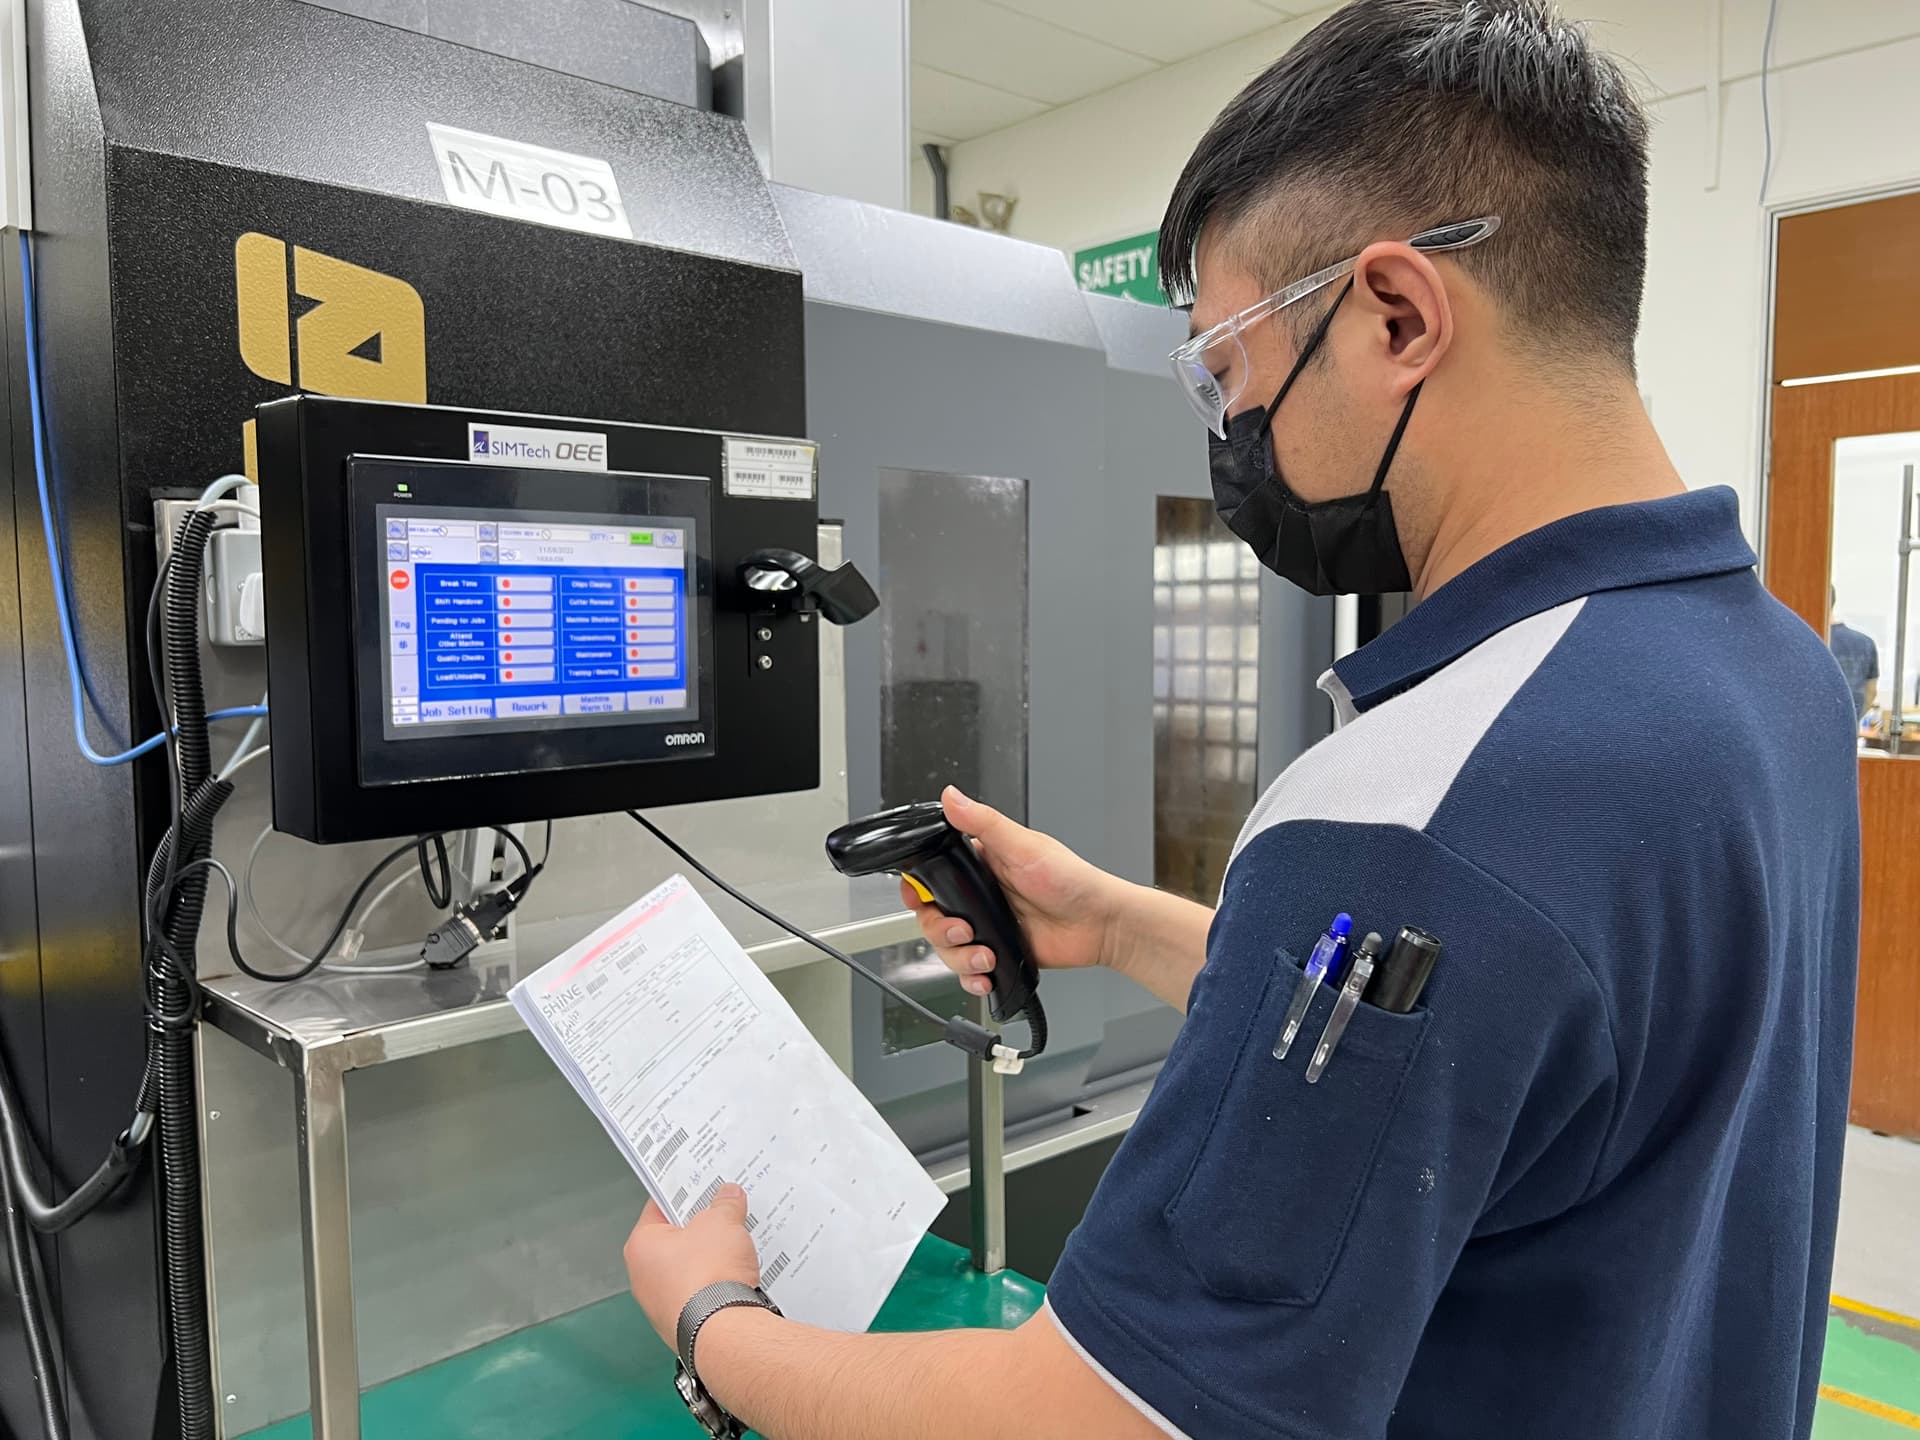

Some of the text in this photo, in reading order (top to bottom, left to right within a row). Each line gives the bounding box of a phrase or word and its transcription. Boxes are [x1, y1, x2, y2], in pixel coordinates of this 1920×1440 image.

[447, 150, 617, 223] M-03
[1079, 246, 1153, 291] SAFETY
[491, 440, 605, 462] SIMTech OEE
[440, 580, 478, 588] Break Time
[435, 598, 451, 606] Shift
[395, 620, 411, 630] Eng
[431, 617, 458, 626] Pending
[436, 654, 485, 664] Quality Checks
[512, 702, 548, 713] Rework
[422, 709, 443, 722] Job
[447, 705, 492, 721] Setting
[664, 733, 705, 747] OMRON
